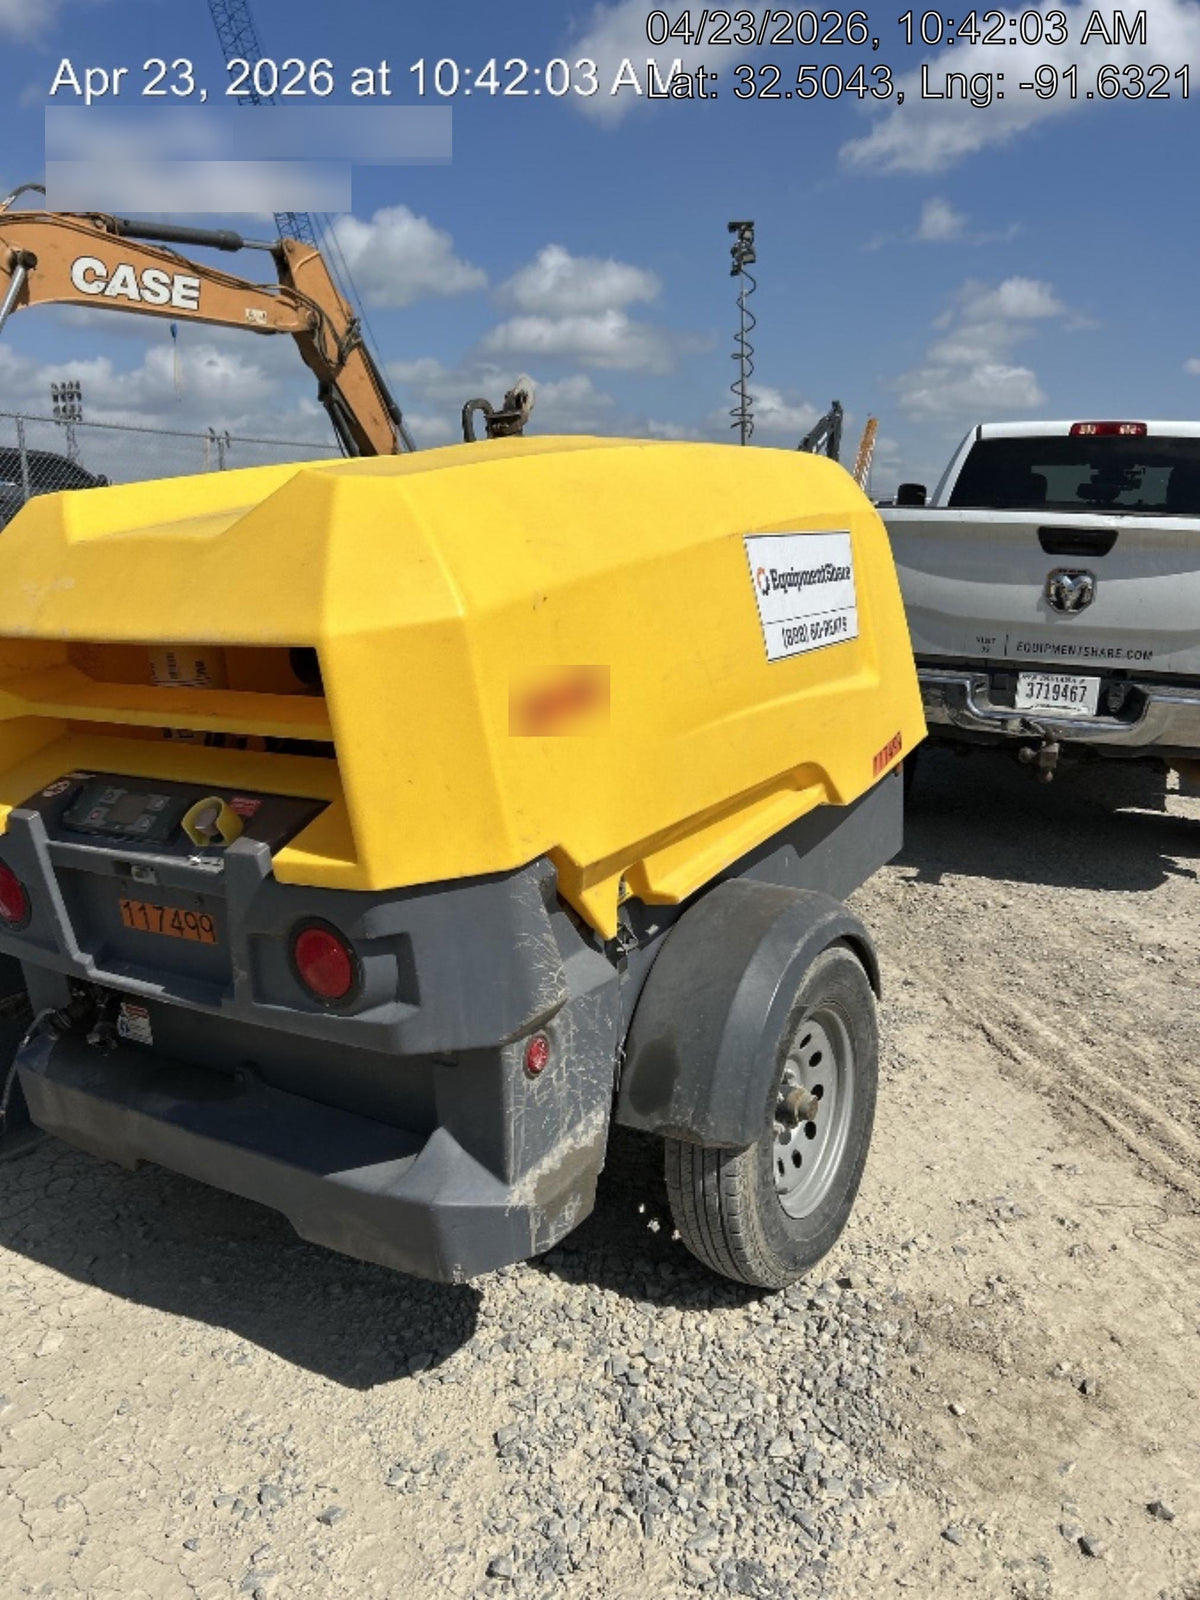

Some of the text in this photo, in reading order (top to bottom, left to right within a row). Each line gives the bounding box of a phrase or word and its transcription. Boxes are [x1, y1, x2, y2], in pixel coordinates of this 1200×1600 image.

[70, 256, 201, 311] CASE
[769, 563, 851, 594] EquipmentShare
[1016, 641, 1153, 661] EQUIPMENTSHARE.COM
[1025, 682, 1088, 703] 3719467
[121, 899, 216, 944] 117499
